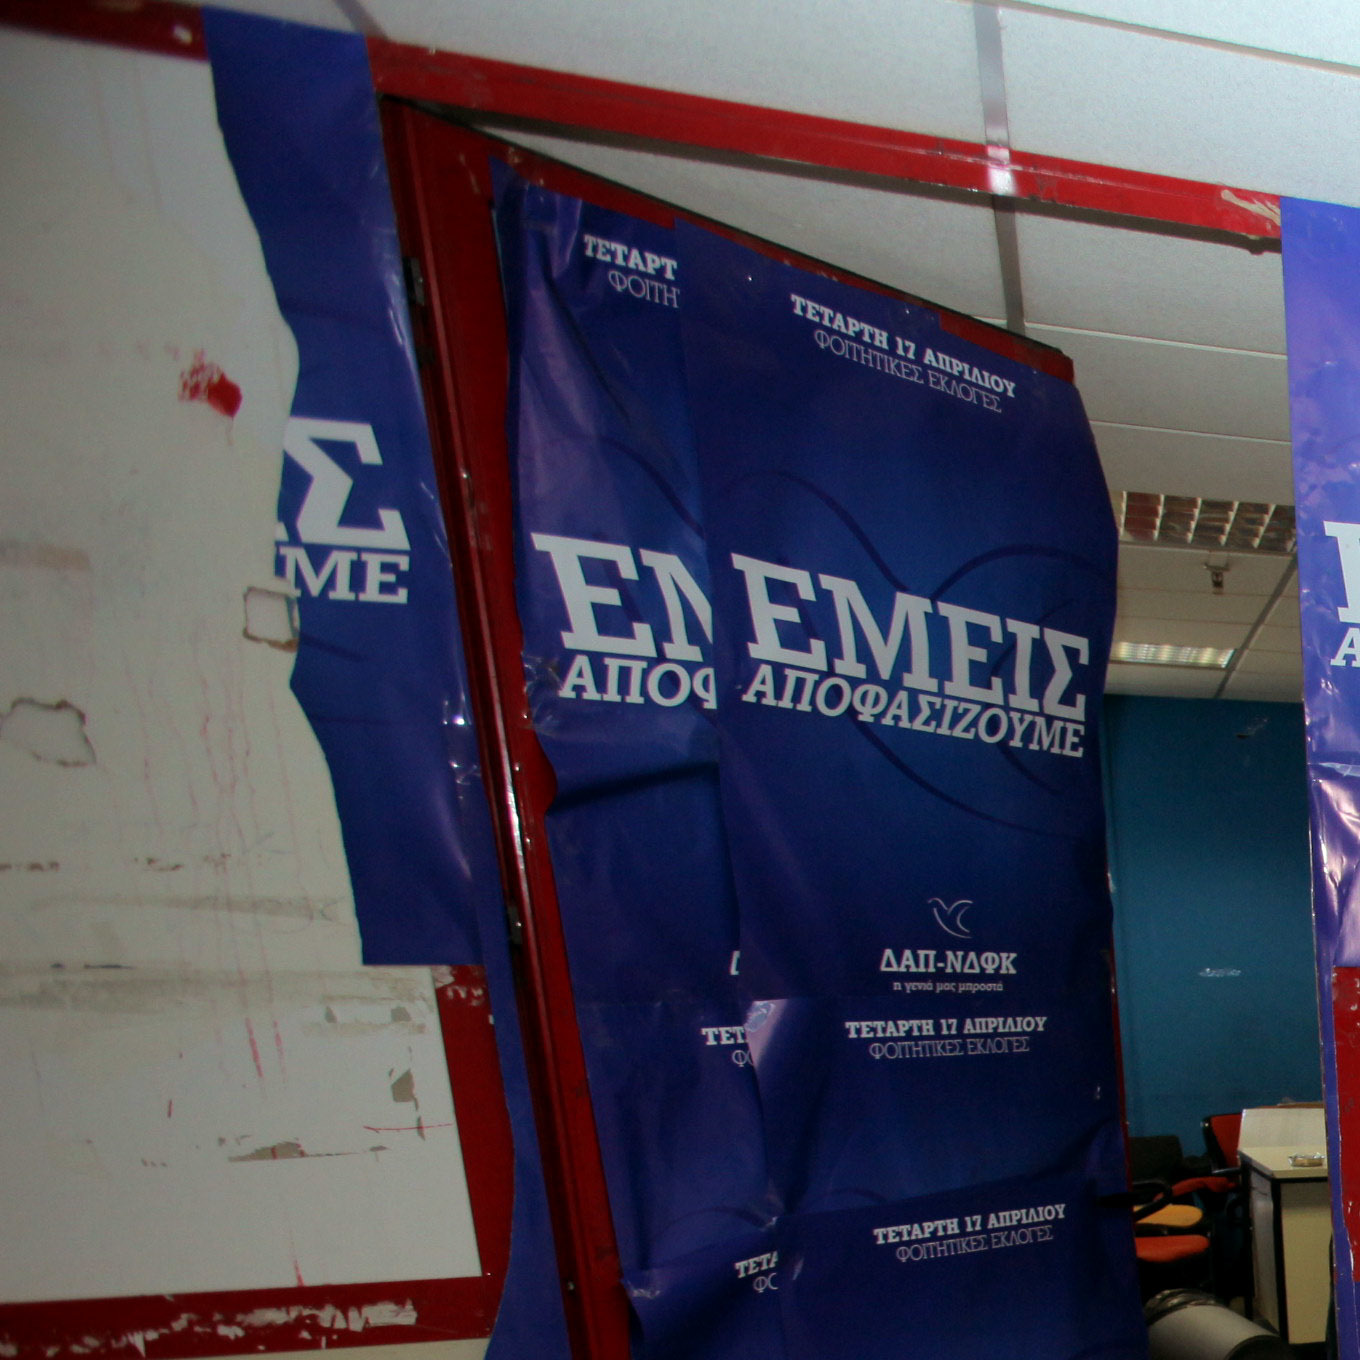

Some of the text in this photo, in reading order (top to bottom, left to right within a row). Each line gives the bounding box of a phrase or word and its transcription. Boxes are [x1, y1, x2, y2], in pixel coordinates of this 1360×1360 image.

[583, 234, 678, 280] ΤΕΤΑΡΤ
[790, 294, 1016, 399] ΤΕΤΑΡΤΗ 17 ΑΠΡΙΛΙΟΥ
[814, 328, 1002, 414] ΦΟΙΤΗΤΙΚΕΣ ΕΚΛΟΓΕΣ
[275, 415, 410, 550] Σ
[730, 552, 1089, 723] ΕΜΕΙΣ
[741, 663, 1086, 758] ΑΠΟΦΑΣΙΖΟΥΜΕ
[880, 948, 1018, 975] ΔΑΠ-ΝΔΦΚ
[904, 980, 933, 993] γενιά
[935, 982, 957, 993] μας
[958, 980, 1004, 993] μπροστά
[845, 1015, 1047, 1039] ΤΕΤΑΡΤΗ 17 ΑΠΡΙΛΙΟΥ
[868, 1036, 1030, 1060] ΦΟΙΤΗΤΙΚΕΣ ΕΚΛΟΓΕΣ
[873, 1203, 1066, 1246] ΤΕΤΑΡΤΗ 17 ΑΠΡΙΛΙΟΥ
[896, 1225, 1054, 1264] ΦΟΙΤΗΤΙΚΕΣ ΕΚΛΟΓΕΣ
